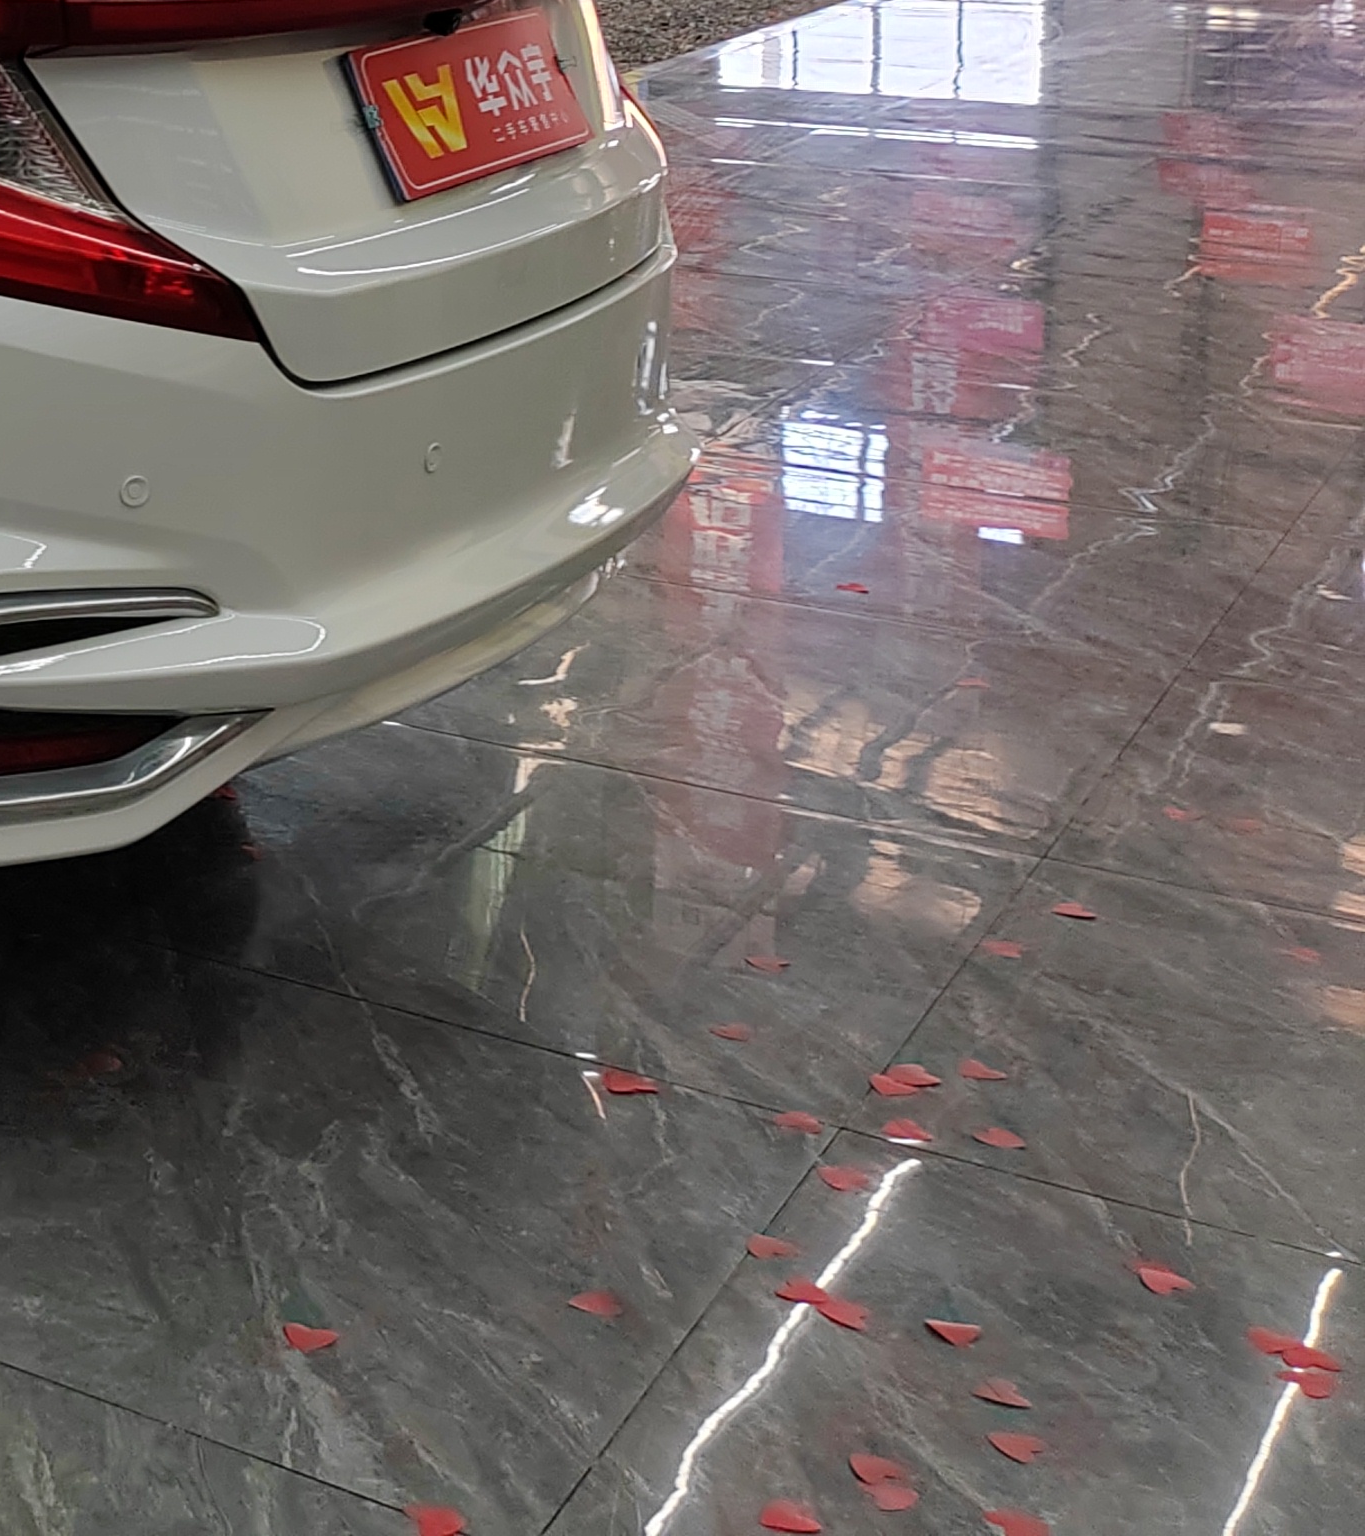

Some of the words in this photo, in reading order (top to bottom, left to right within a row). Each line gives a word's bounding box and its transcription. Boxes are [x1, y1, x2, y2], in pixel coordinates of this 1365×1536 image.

[464, 43, 552, 117] 华众宇
[492, 112, 569, 143] 二手车寄售中心
